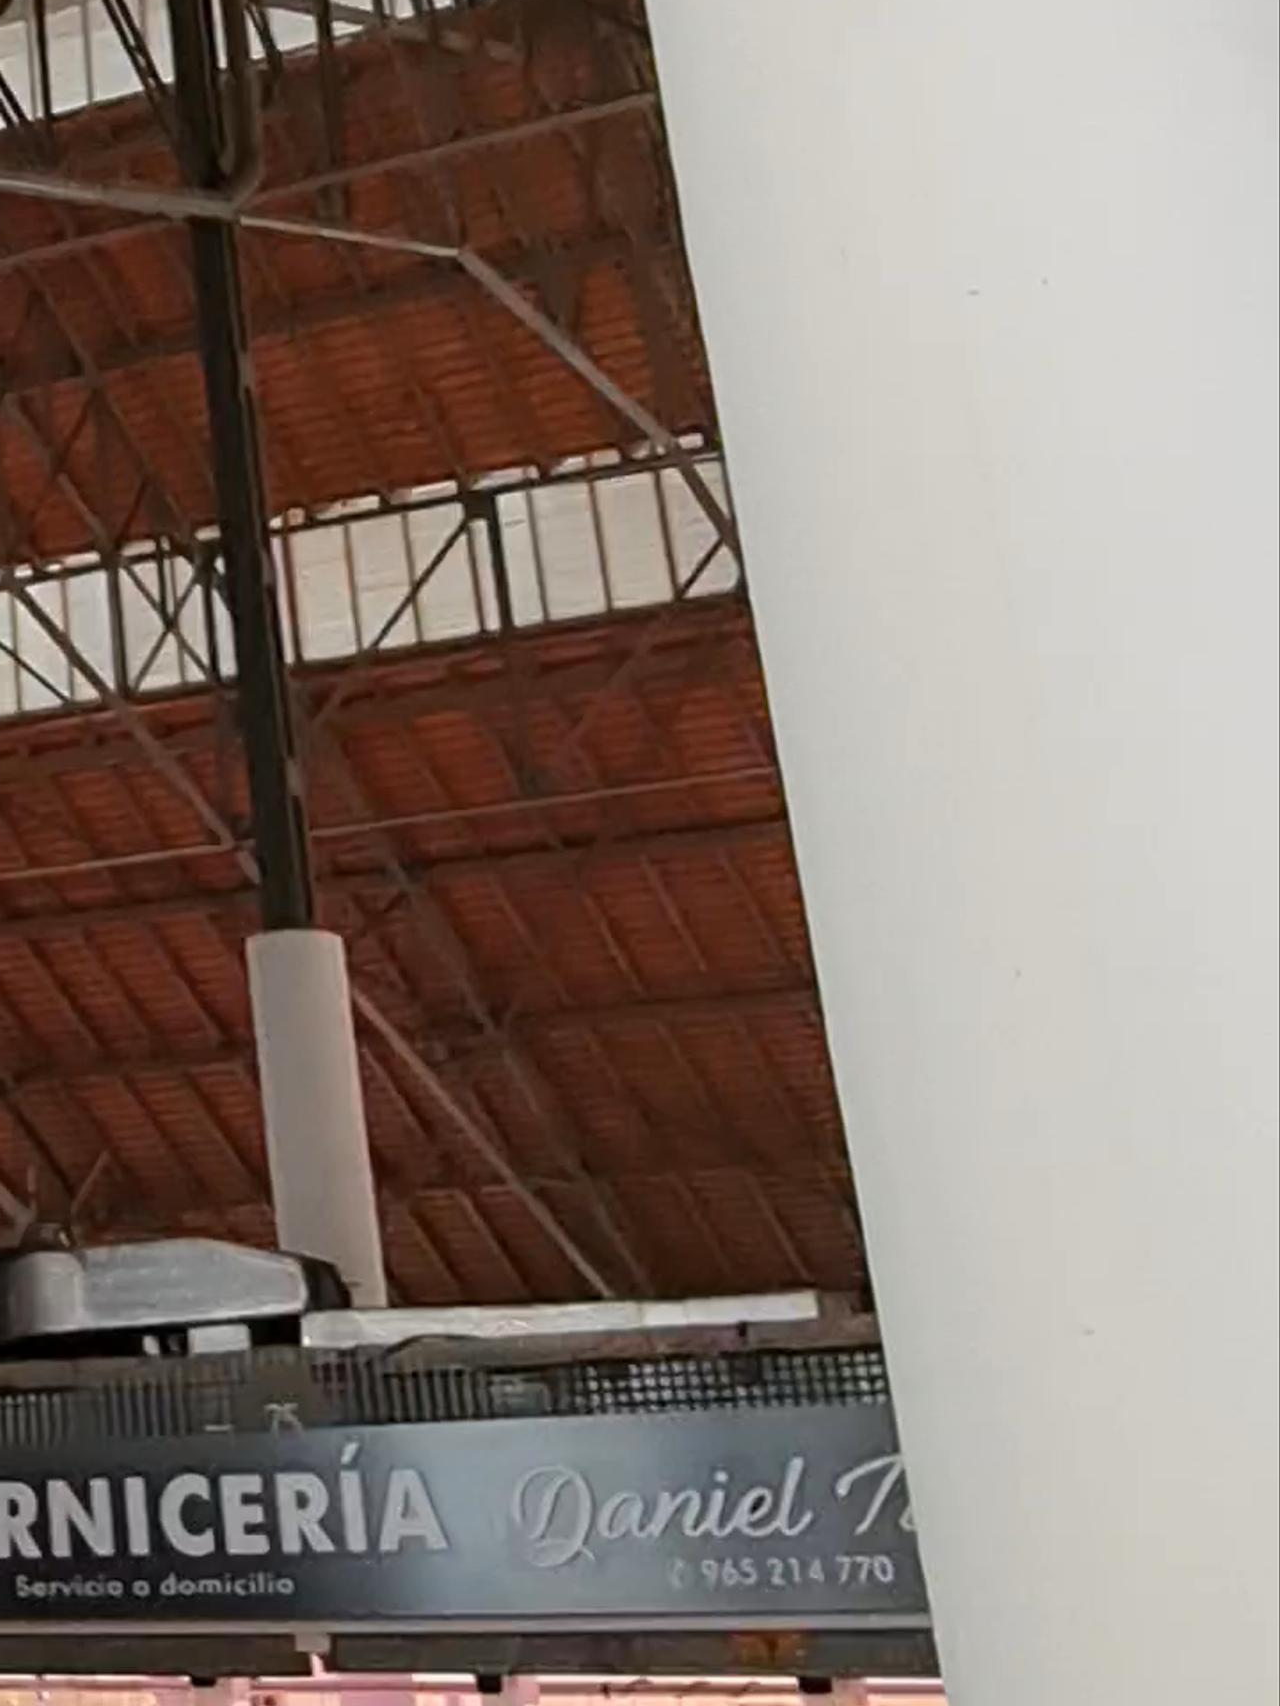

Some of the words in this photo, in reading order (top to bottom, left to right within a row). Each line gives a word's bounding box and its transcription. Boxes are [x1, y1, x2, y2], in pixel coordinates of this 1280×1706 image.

[510, 1455, 814, 1568] Daniel
[14, 1573, 124, 1599] Servicio
[159, 1571, 295, 1597] domicilio
[700, 1557, 758, 1587] 965
[766, 1556, 826, 1585] 214
[835, 1554, 895, 1584] 770
